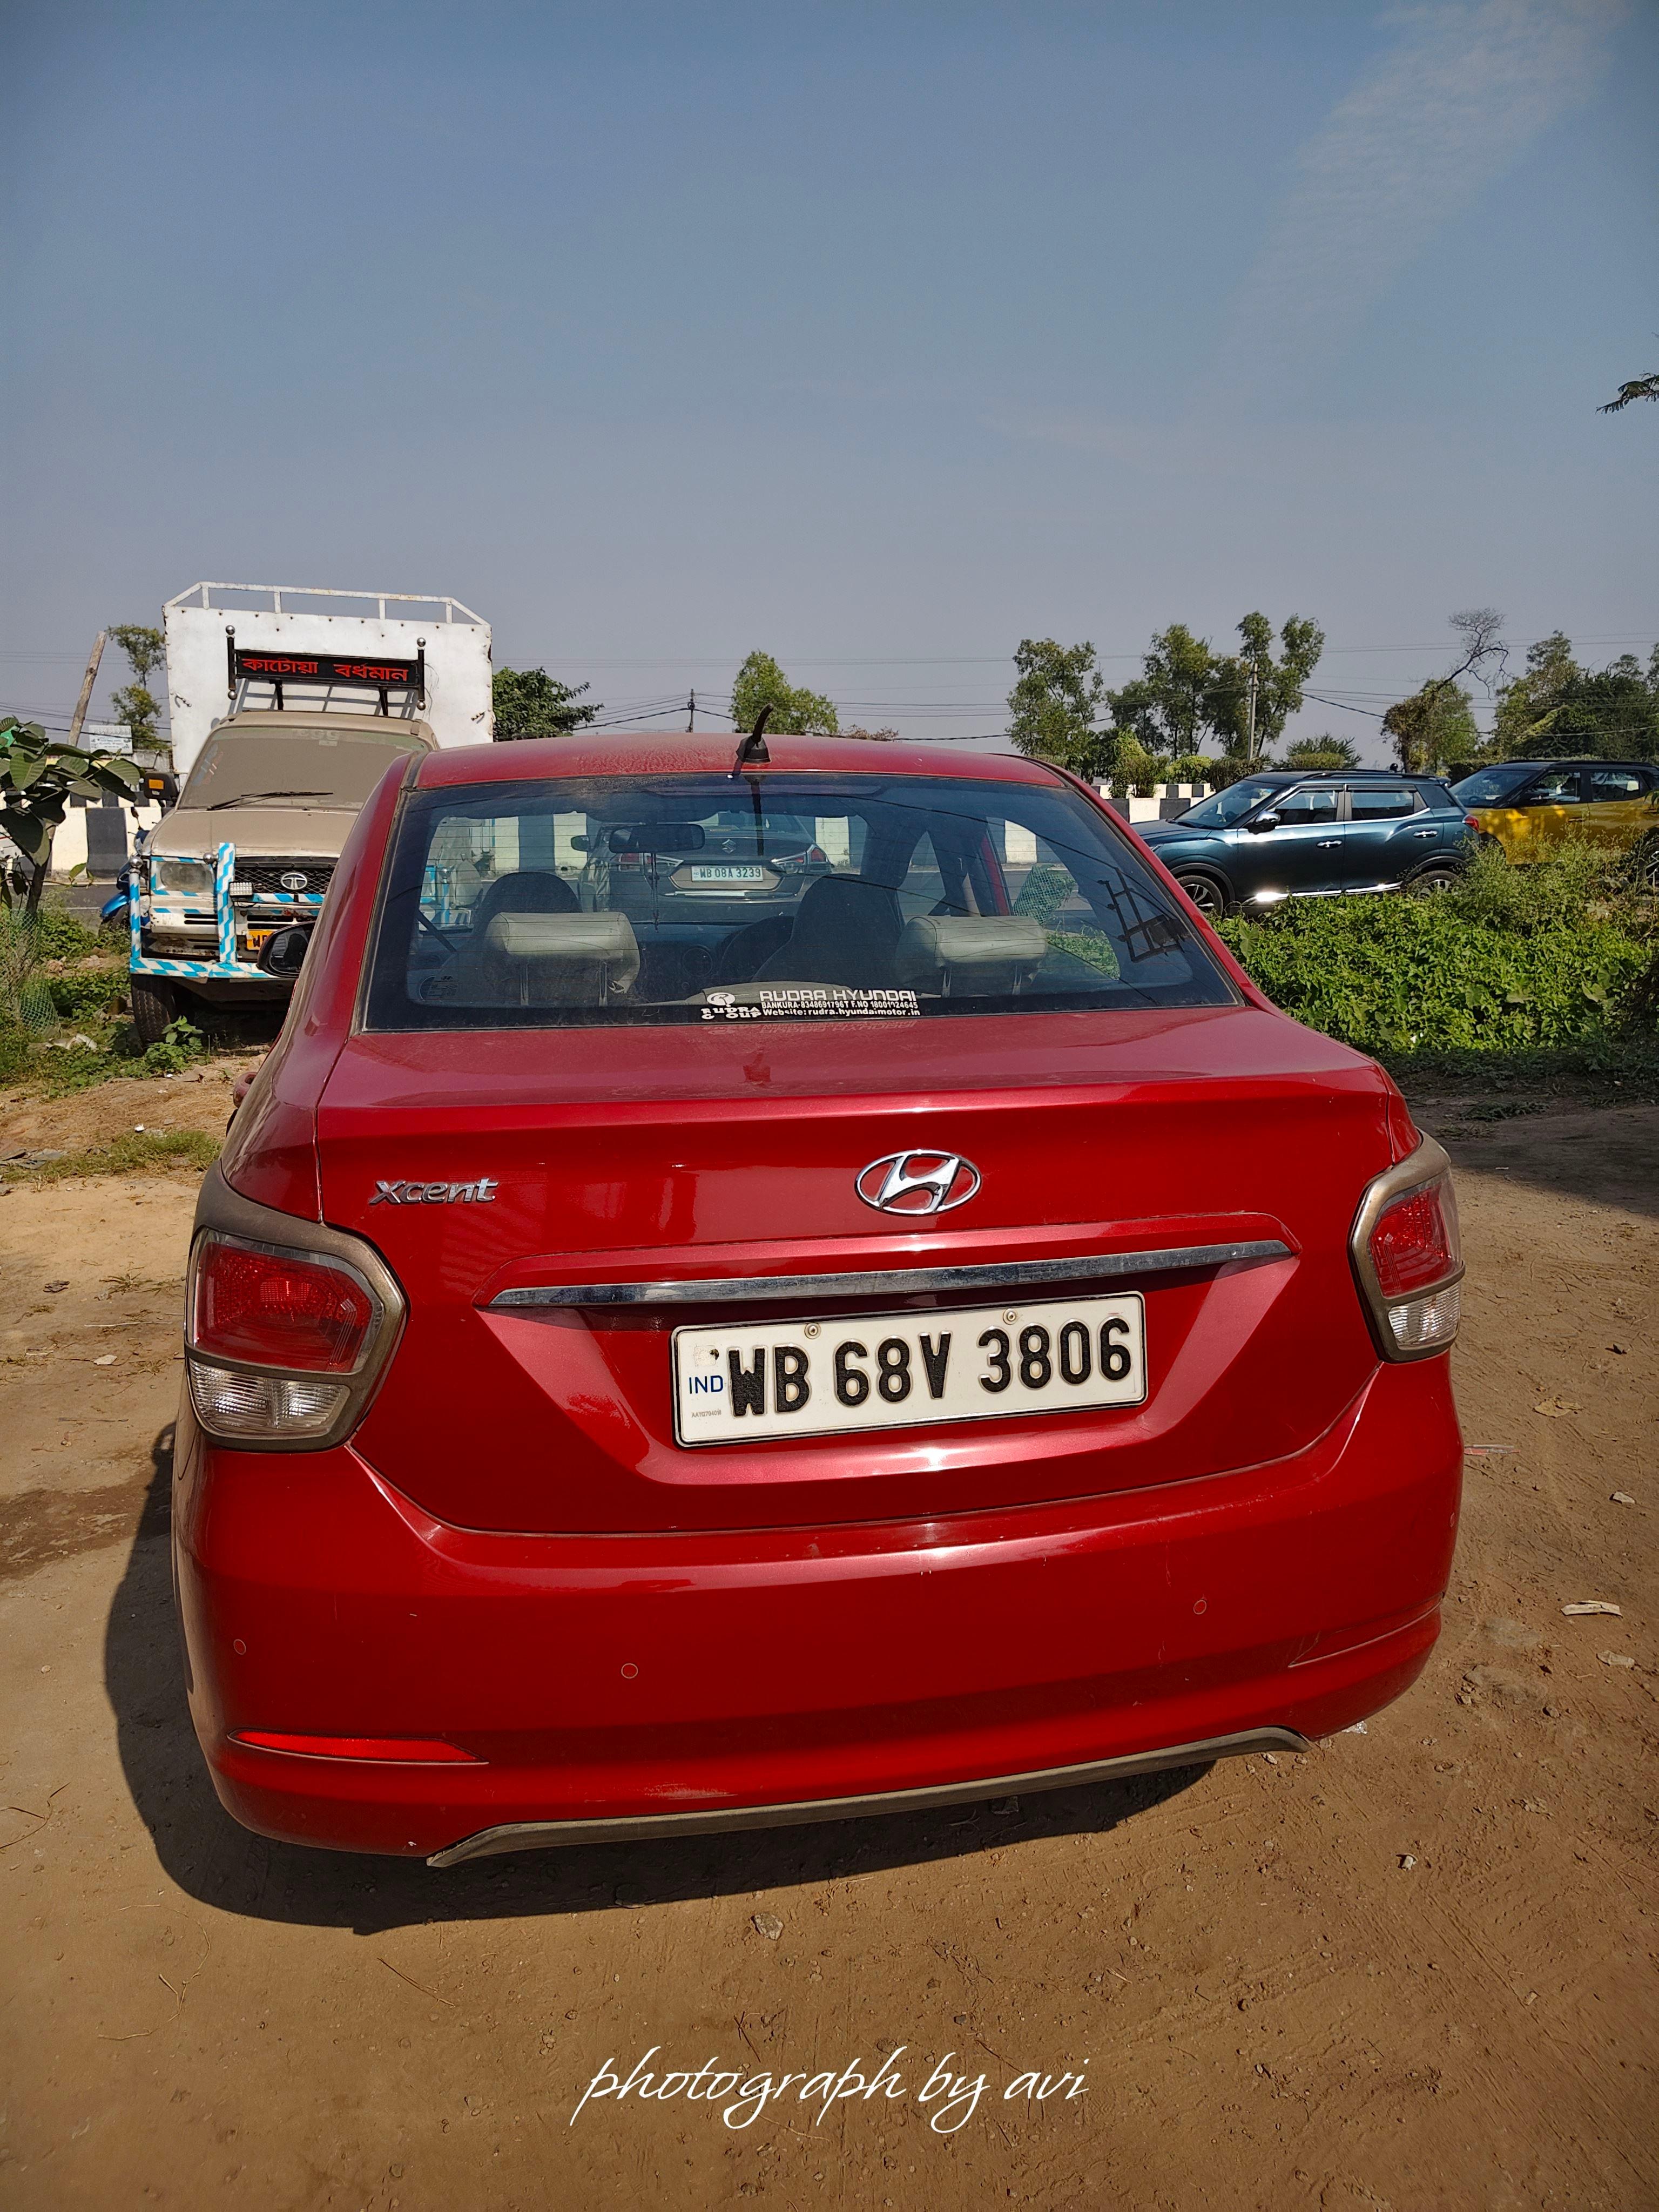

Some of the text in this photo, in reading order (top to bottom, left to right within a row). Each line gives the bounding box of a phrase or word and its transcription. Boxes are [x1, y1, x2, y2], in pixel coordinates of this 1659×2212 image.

[241, 658, 408, 681] কাটোয়া বর্ধমান
[700, 868, 712, 878] WB
[714, 868, 733, 878] 08A
[736, 867, 761, 878] 3239
[759, 989, 917, 1002] RUDRA HYUNDAI
[727, 1316, 1132, 1417] WB 68V 3806
[689, 1375, 724, 1394] IND
